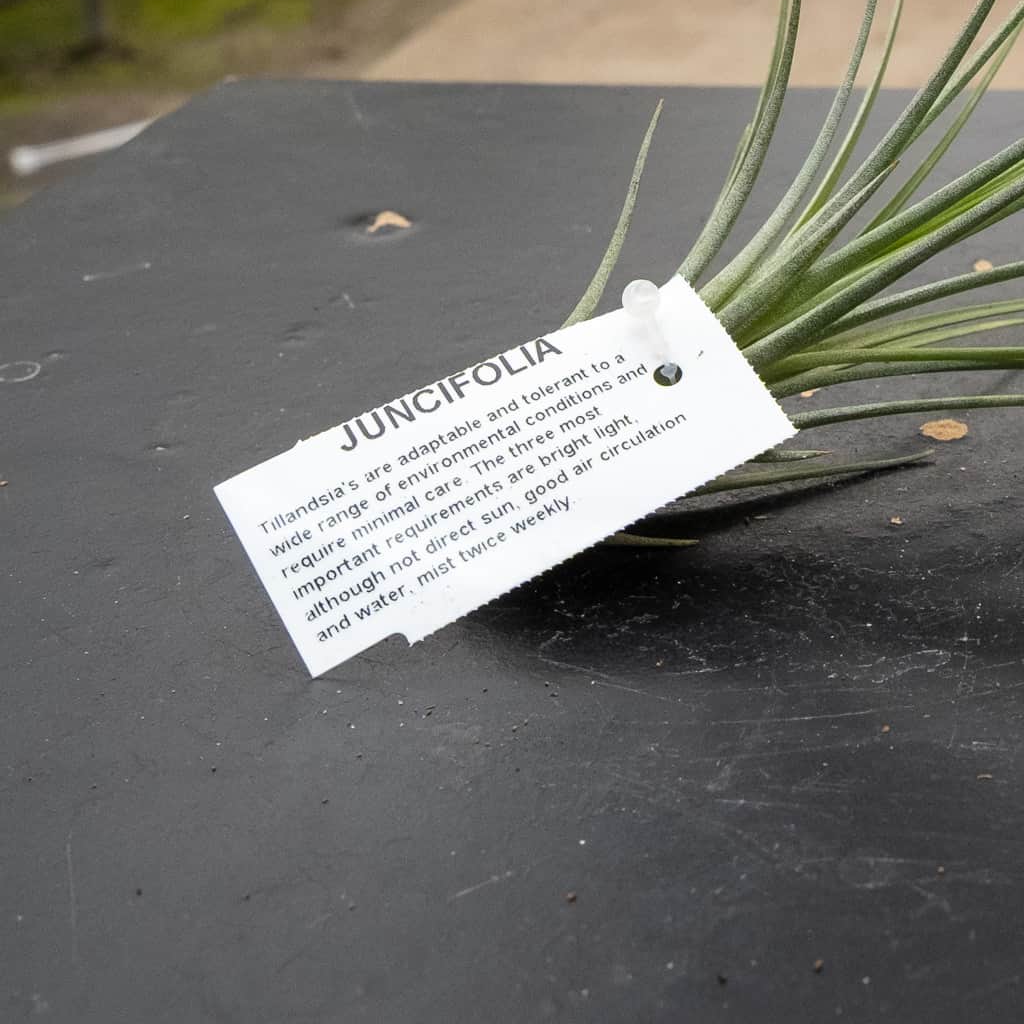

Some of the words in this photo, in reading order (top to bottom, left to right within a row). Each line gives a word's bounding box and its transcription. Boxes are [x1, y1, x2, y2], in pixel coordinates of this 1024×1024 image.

[258, 479, 360, 534] Tillandsia's
[364, 463, 393, 483] are
[397, 419, 482, 466] adaptable
[486, 399, 520, 422] and
[521, 368, 590, 405] tolerant
[591, 360, 611, 375] to
[613, 353, 627, 365] a
[269, 529, 313, 557] wide
[317, 499, 369, 532] range
[375, 482, 392, 502] of
[397, 420, 521, 490] environmental
[525, 380, 613, 426] conditions
[616, 363, 648, 385] and
[340, 338, 563, 452] JUNCIFOLIA
[281, 537, 346, 579] require
[351, 495, 421, 541] minimal
[469, 455, 505, 476] The
[508, 430, 555, 458] three
[559, 405, 601, 433] most
[292, 543, 381, 601] important
[385, 480, 504, 549] requirements
[507, 464, 536, 484] are
[537, 433, 592, 468] bright
[305, 570, 386, 622] although
[389, 549, 421, 575] not
[425, 519, 477, 554] direct
[480, 501, 521, 525] sun,
[524, 469, 569, 505] good
[572, 457, 593, 476] air
[600, 414, 687, 462] circulation
[316, 613, 352, 642] and
[353, 584, 414, 621] water,
[416, 556, 456, 587] mist
[458, 531, 505, 562] twice
